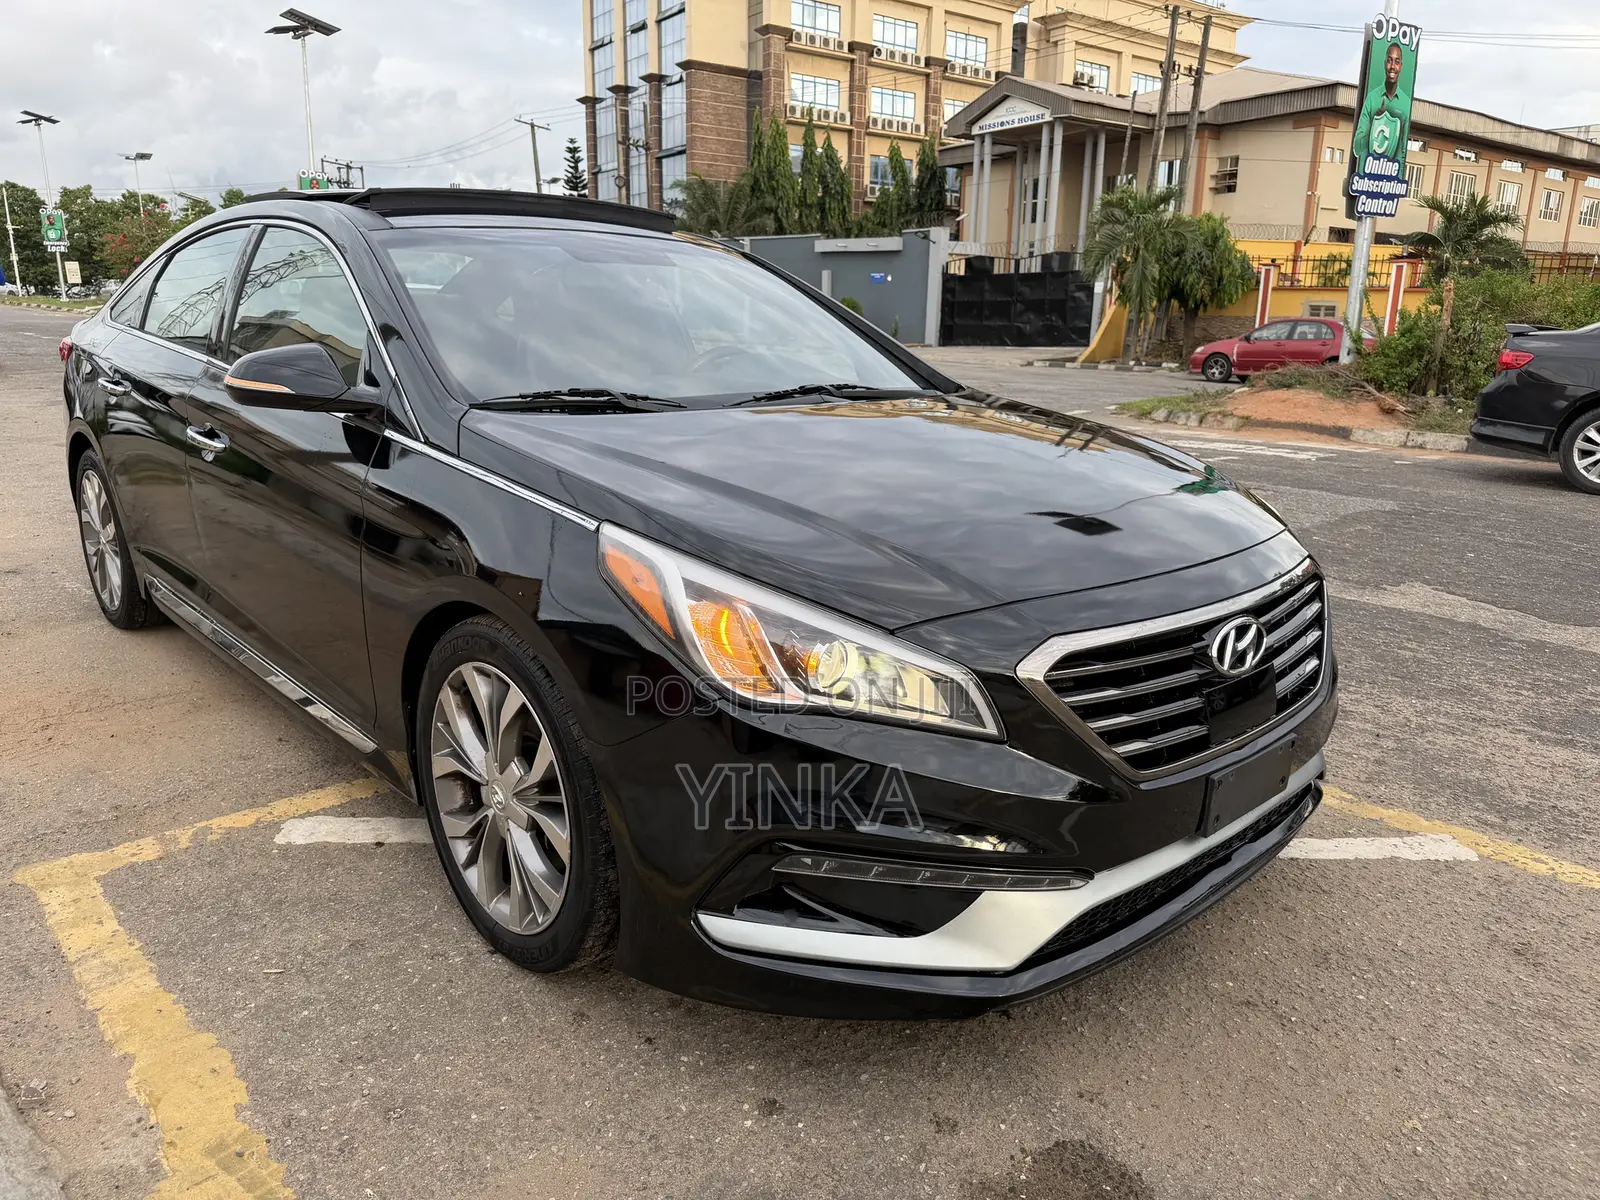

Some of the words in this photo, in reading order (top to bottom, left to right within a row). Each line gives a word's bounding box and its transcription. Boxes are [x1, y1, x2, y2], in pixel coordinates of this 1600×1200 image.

[1372, 13, 1422, 51] OPay
[978, 118, 1015, 131] MISSIONS
[1017, 113, 1046, 124] HOUSE
[299, 169, 328, 181] OPay
[1364, 156, 1400, 178] Online
[1352, 175, 1407, 195] Subscription
[1357, 195, 1398, 215] Control
